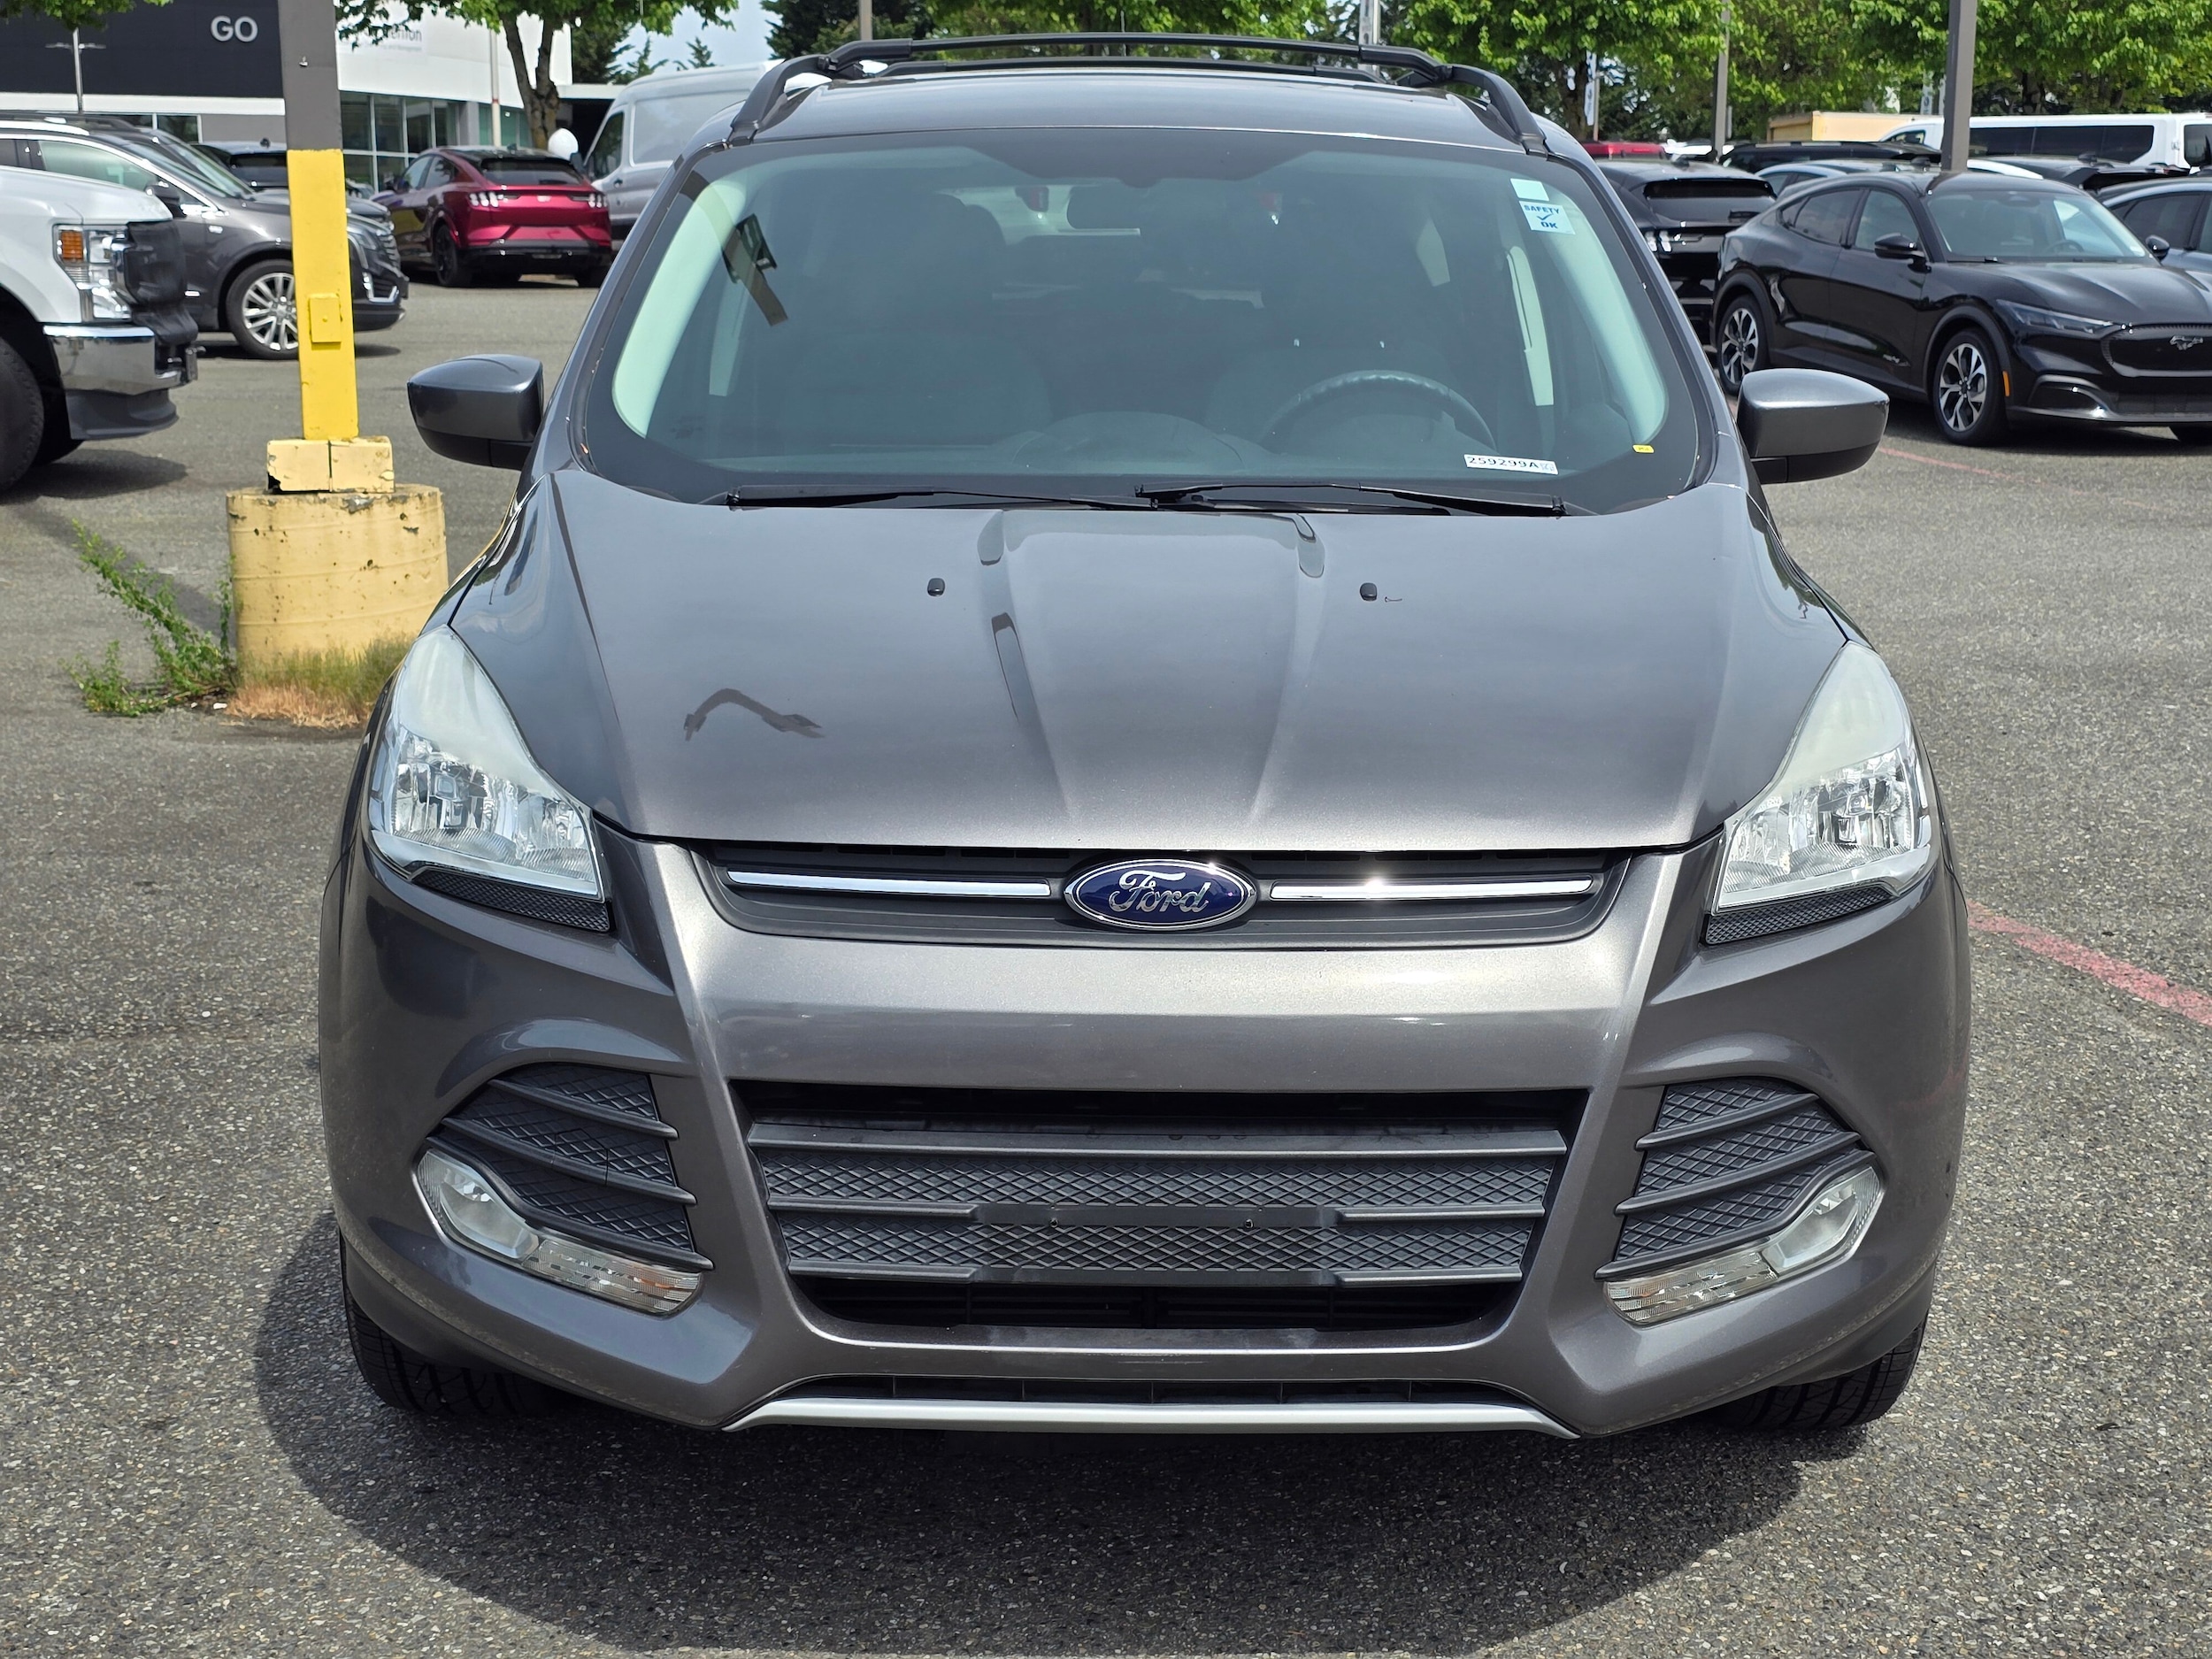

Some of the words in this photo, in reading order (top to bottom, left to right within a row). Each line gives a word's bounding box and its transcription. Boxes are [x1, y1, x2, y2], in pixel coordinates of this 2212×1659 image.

[210, 15, 258, 42] GO
[1524, 204, 1559, 214] SAFETY
[1467, 456, 1540, 469] 259299A
[1108, 869, 1211, 913] Ford
